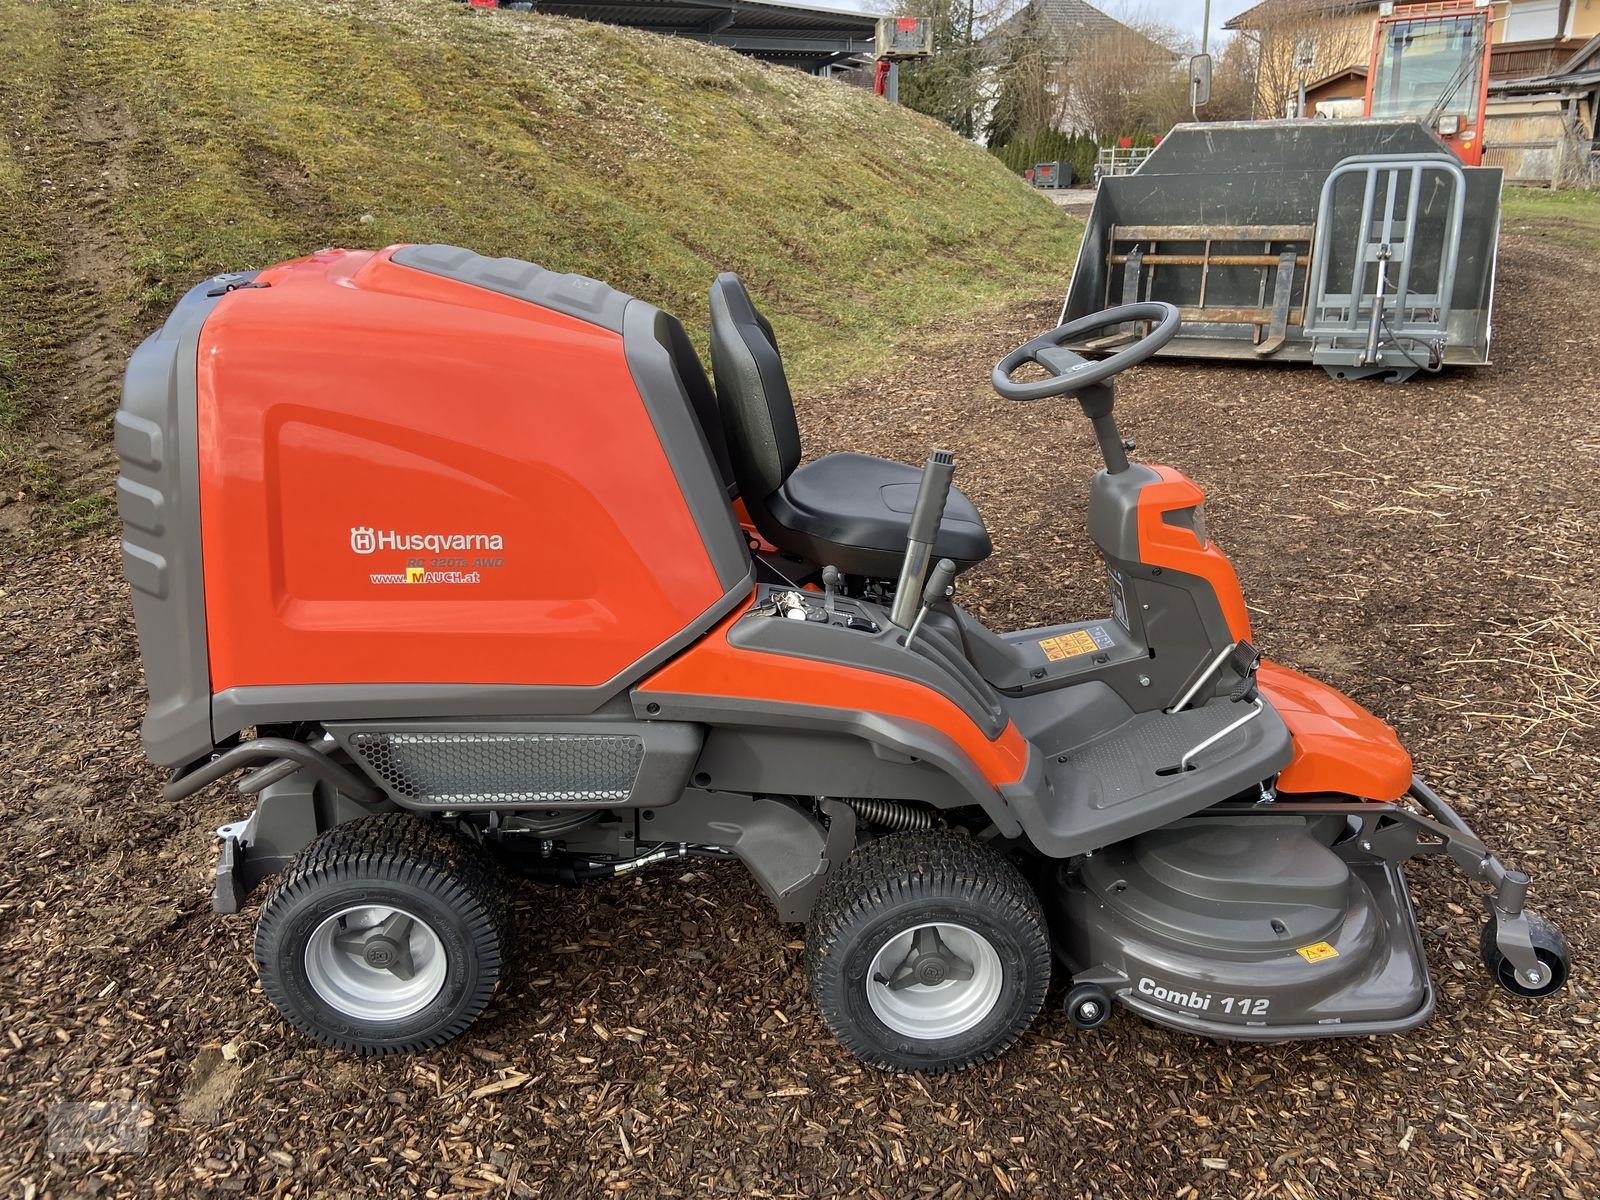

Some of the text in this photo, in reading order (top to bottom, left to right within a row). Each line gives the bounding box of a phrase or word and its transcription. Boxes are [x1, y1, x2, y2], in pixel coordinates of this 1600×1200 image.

[377, 530, 503, 553] Husqvarna
[407, 558, 424, 568] RC
[472, 558, 504, 568] AWD
[1138, 977, 1270, 1015] Combi 112
